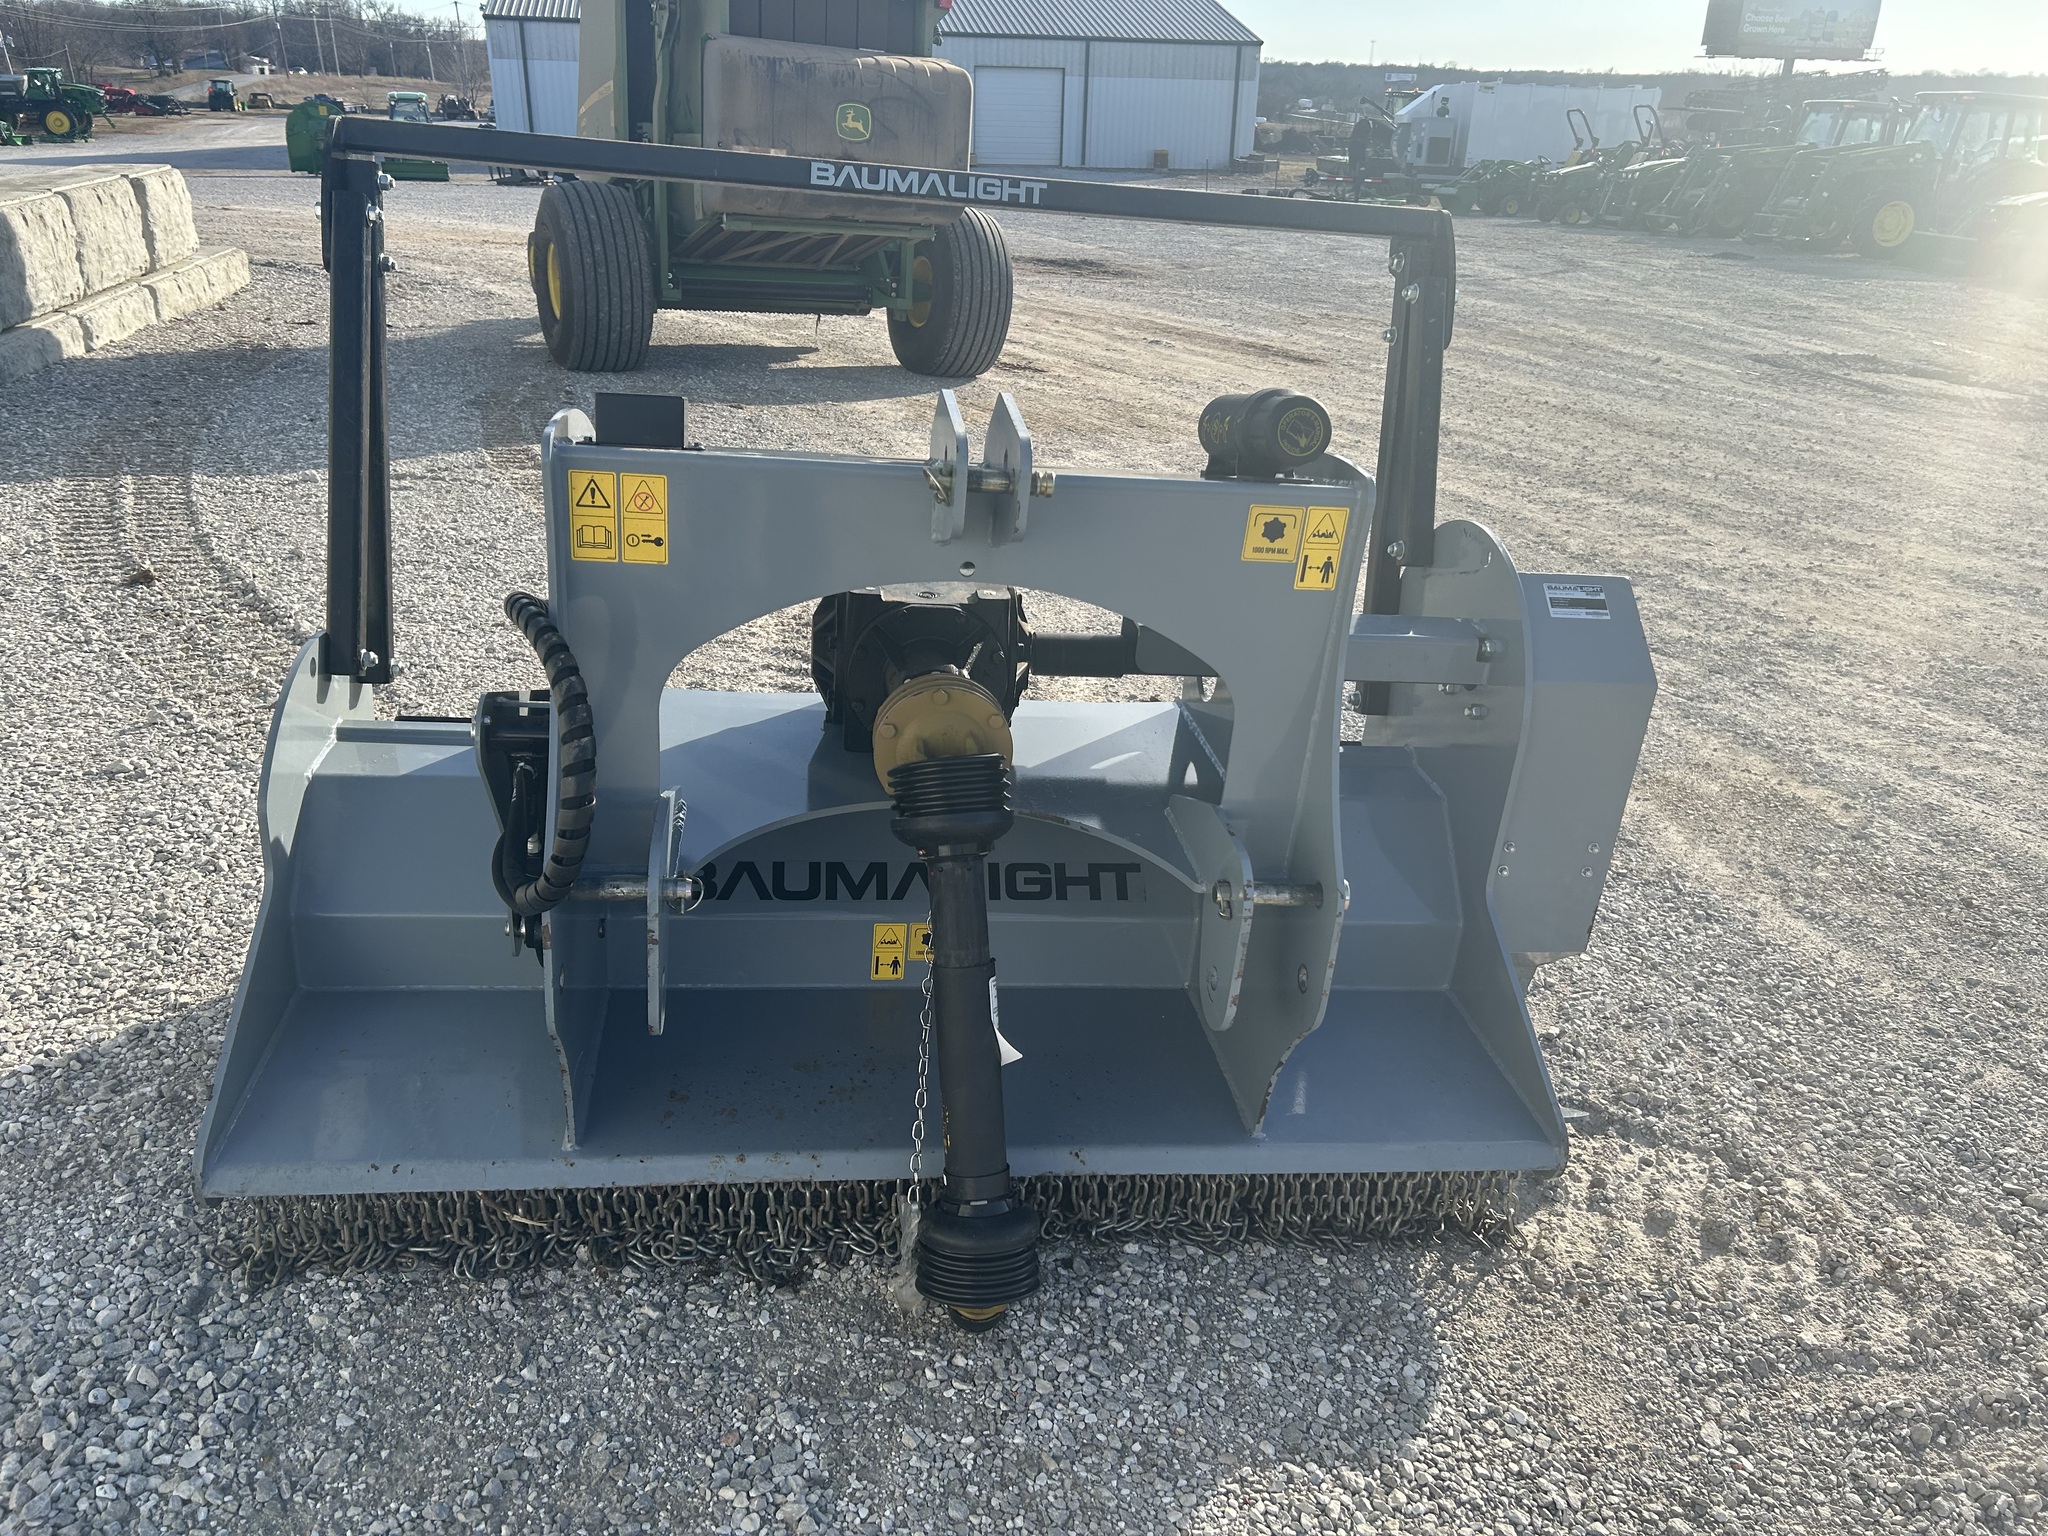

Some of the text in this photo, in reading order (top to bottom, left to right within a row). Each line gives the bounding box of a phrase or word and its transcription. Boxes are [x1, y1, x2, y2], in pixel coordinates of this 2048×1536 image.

[1745, 13, 1774, 23] Choose
[1743, 23, 1786, 34] Grown Here
[810, 161, 1048, 205] BAUMALIGHT
[1252, 546, 1265, 554] 1000
[1264, 547, 1277, 555] RPM
[1547, 585, 1602, 593] BAUMALIGHT
[690, 861, 1142, 901] BAUMAIGHT
